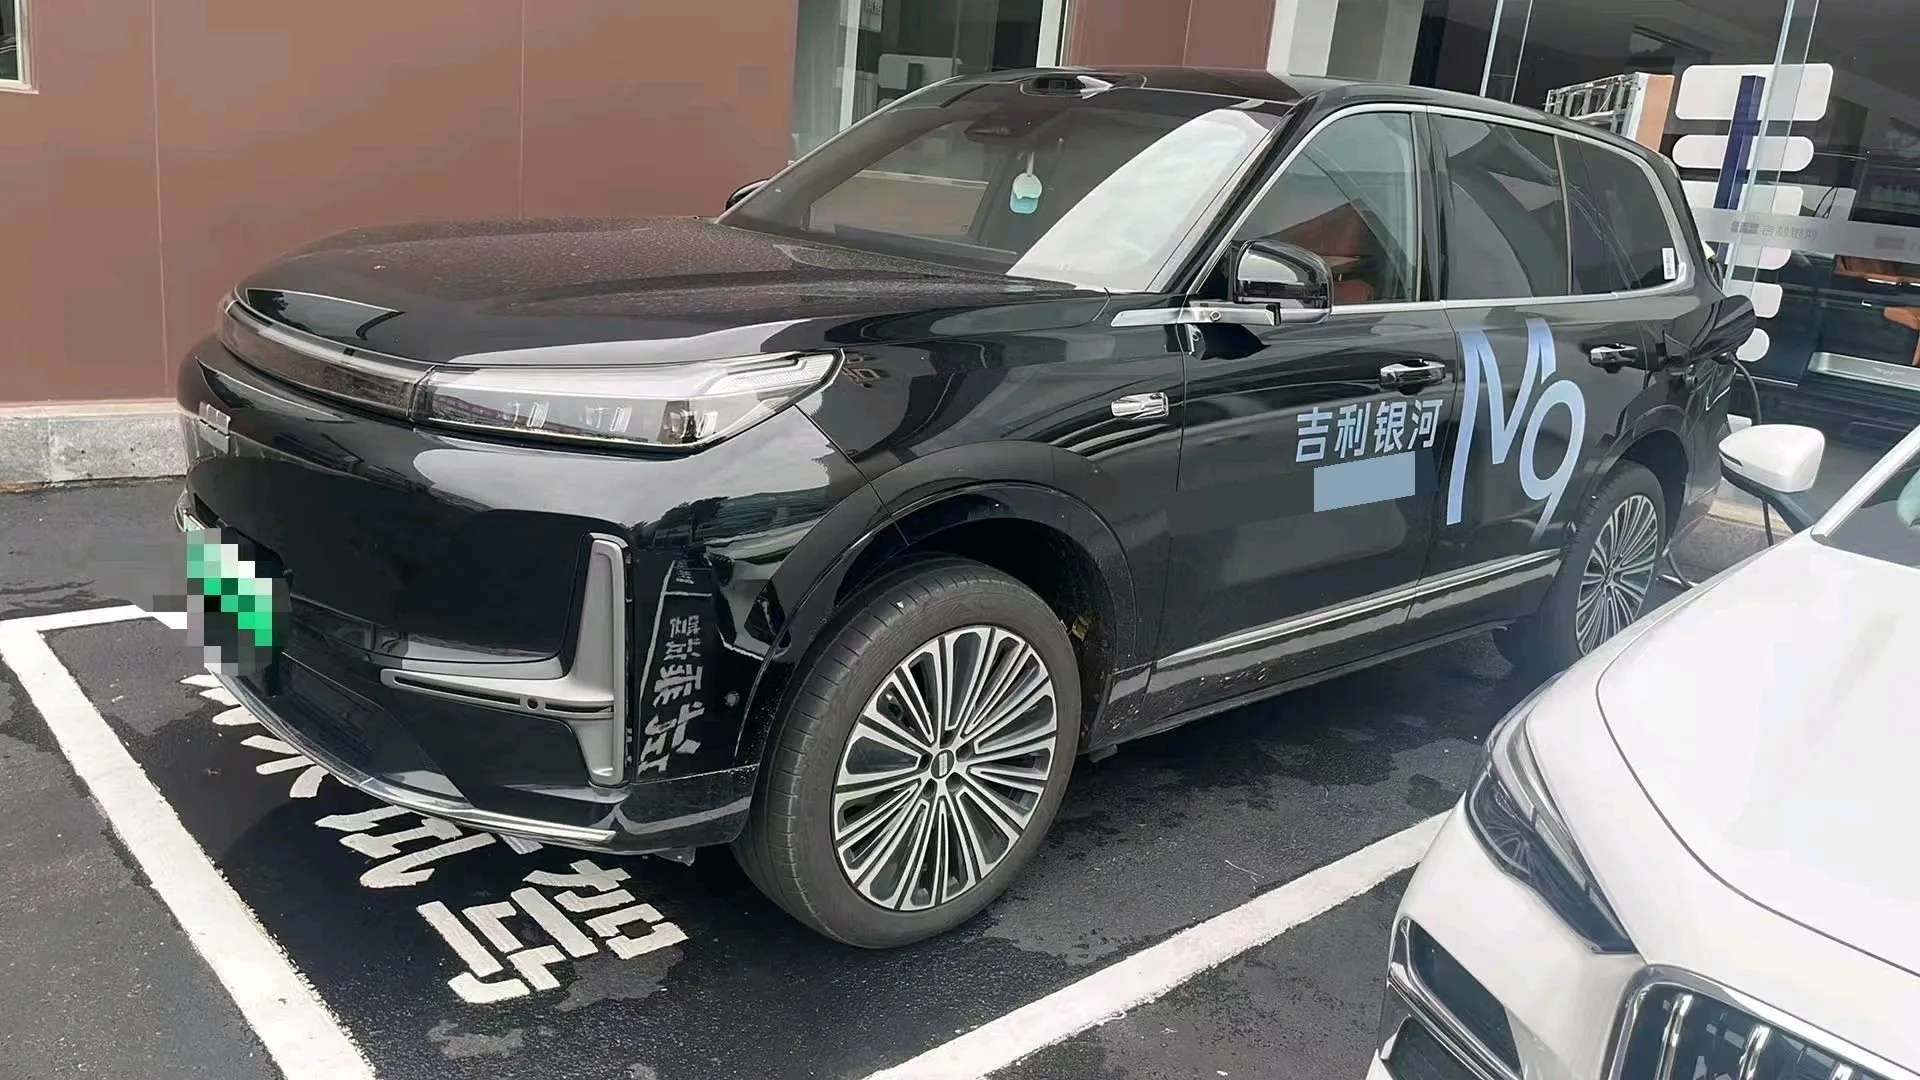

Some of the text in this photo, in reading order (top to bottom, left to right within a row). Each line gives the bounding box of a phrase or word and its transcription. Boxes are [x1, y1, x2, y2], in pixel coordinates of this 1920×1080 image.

[1295, 399, 1443, 462] 吉利银河
[1446, 318, 1586, 545] M9
